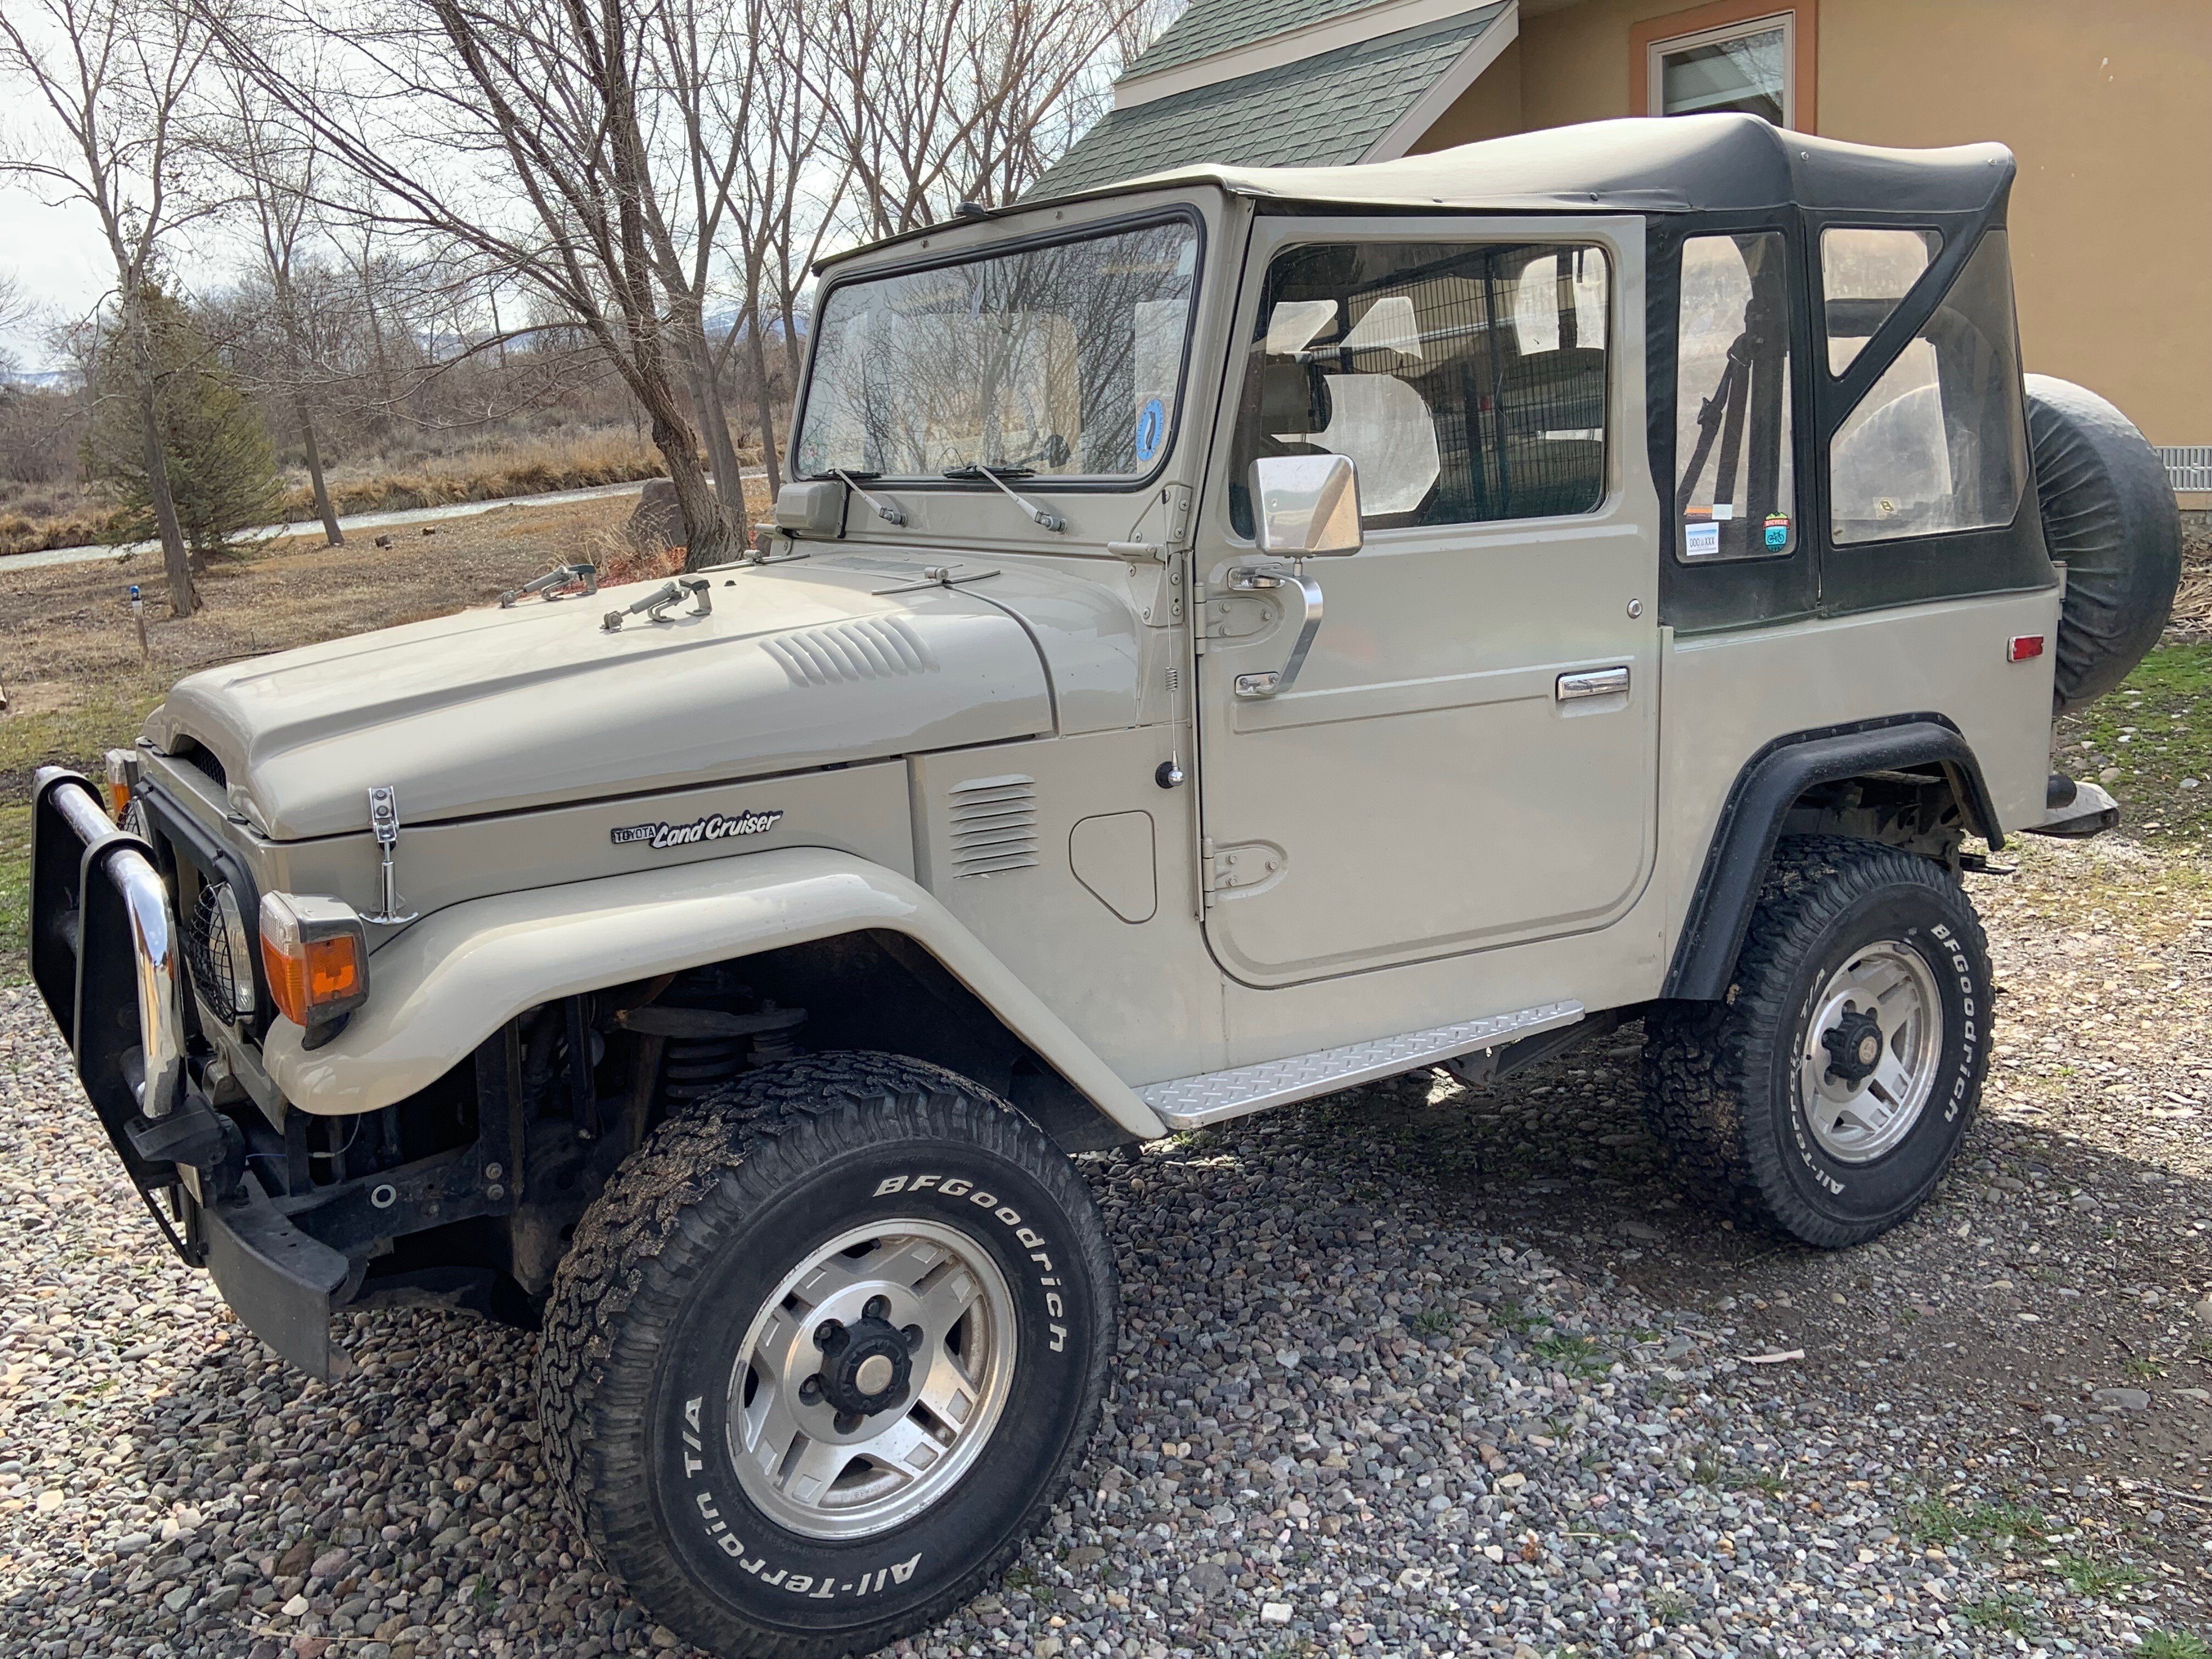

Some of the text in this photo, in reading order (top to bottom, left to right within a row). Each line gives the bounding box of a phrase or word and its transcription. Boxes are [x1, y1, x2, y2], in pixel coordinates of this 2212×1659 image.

[614, 813, 782, 849] TOYOTA Land Cruiser
[1930, 923, 1976, 1124] BFGoodrich
[872, 1175, 1066, 1353] BFGoodrich
[683, 1395, 703, 1479] T/A
[696, 1492, 923, 1599] All-Terrain
